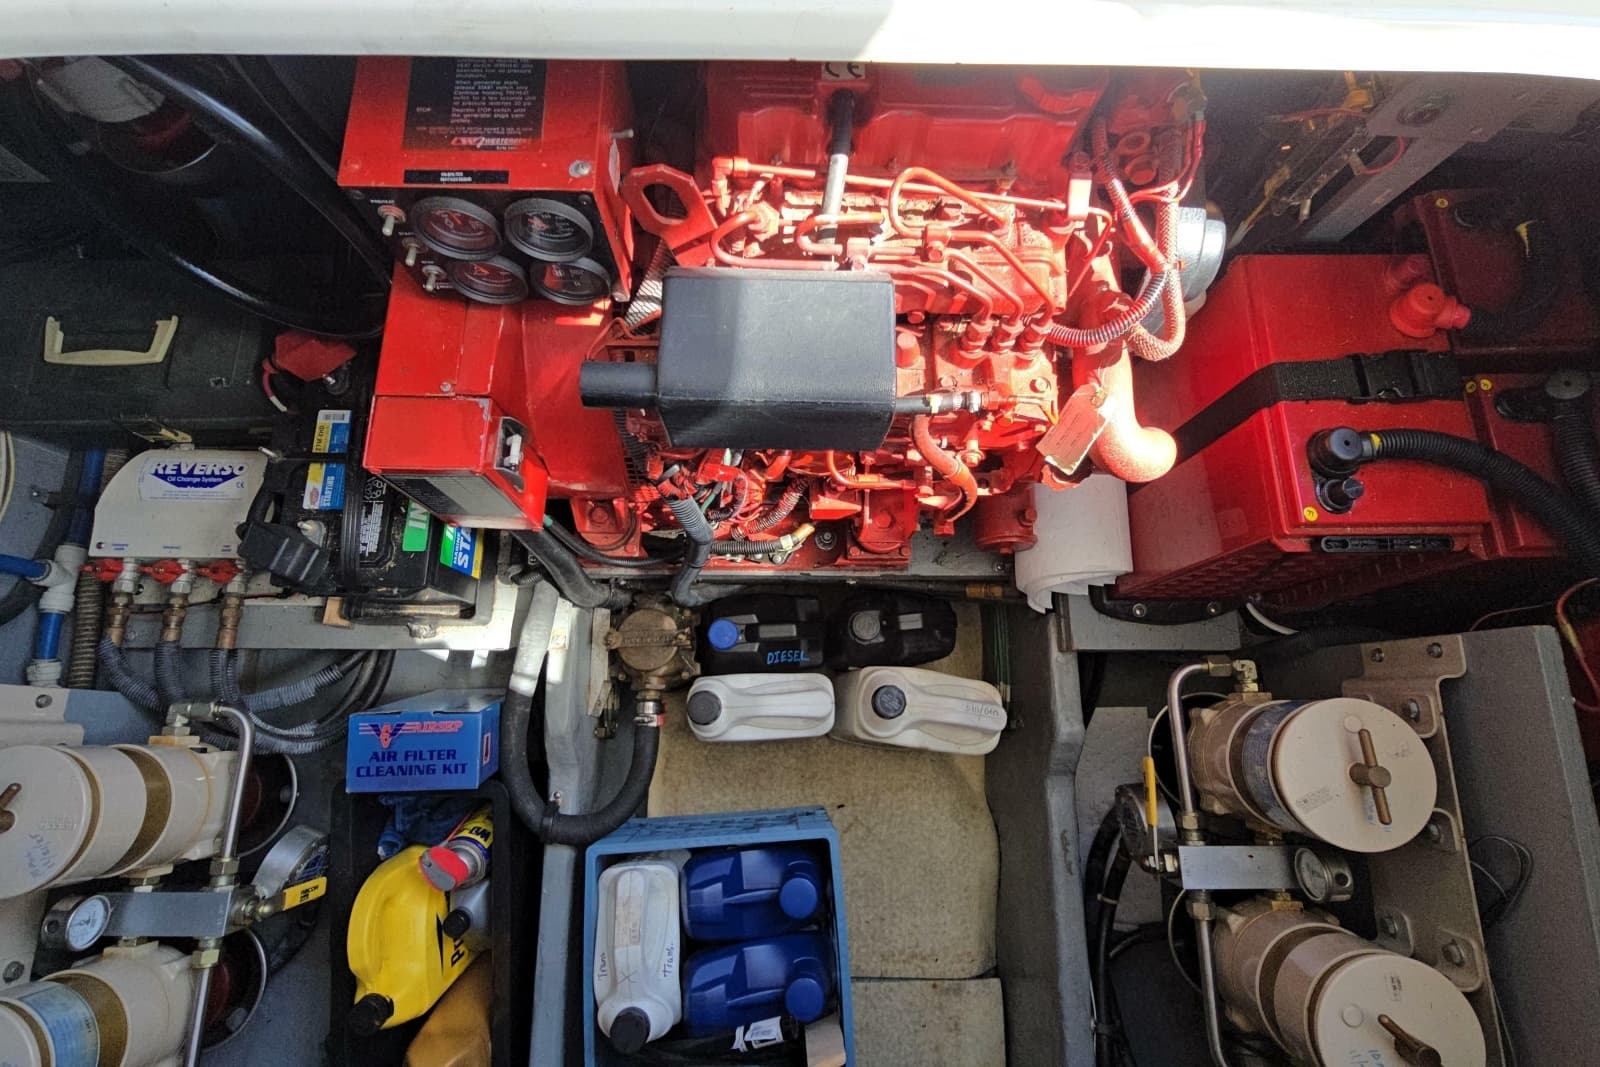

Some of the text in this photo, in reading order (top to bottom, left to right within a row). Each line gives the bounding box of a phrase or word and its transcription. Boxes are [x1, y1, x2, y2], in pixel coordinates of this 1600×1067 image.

[152, 461, 248, 475] REVERSO
[177, 476, 200, 484] Change
[202, 476, 223, 484] System
[766, 649, 810, 665] DIESEL
[369, 749, 457, 763] AIR FILTER
[355, 763, 468, 778] CLEANING KIT
